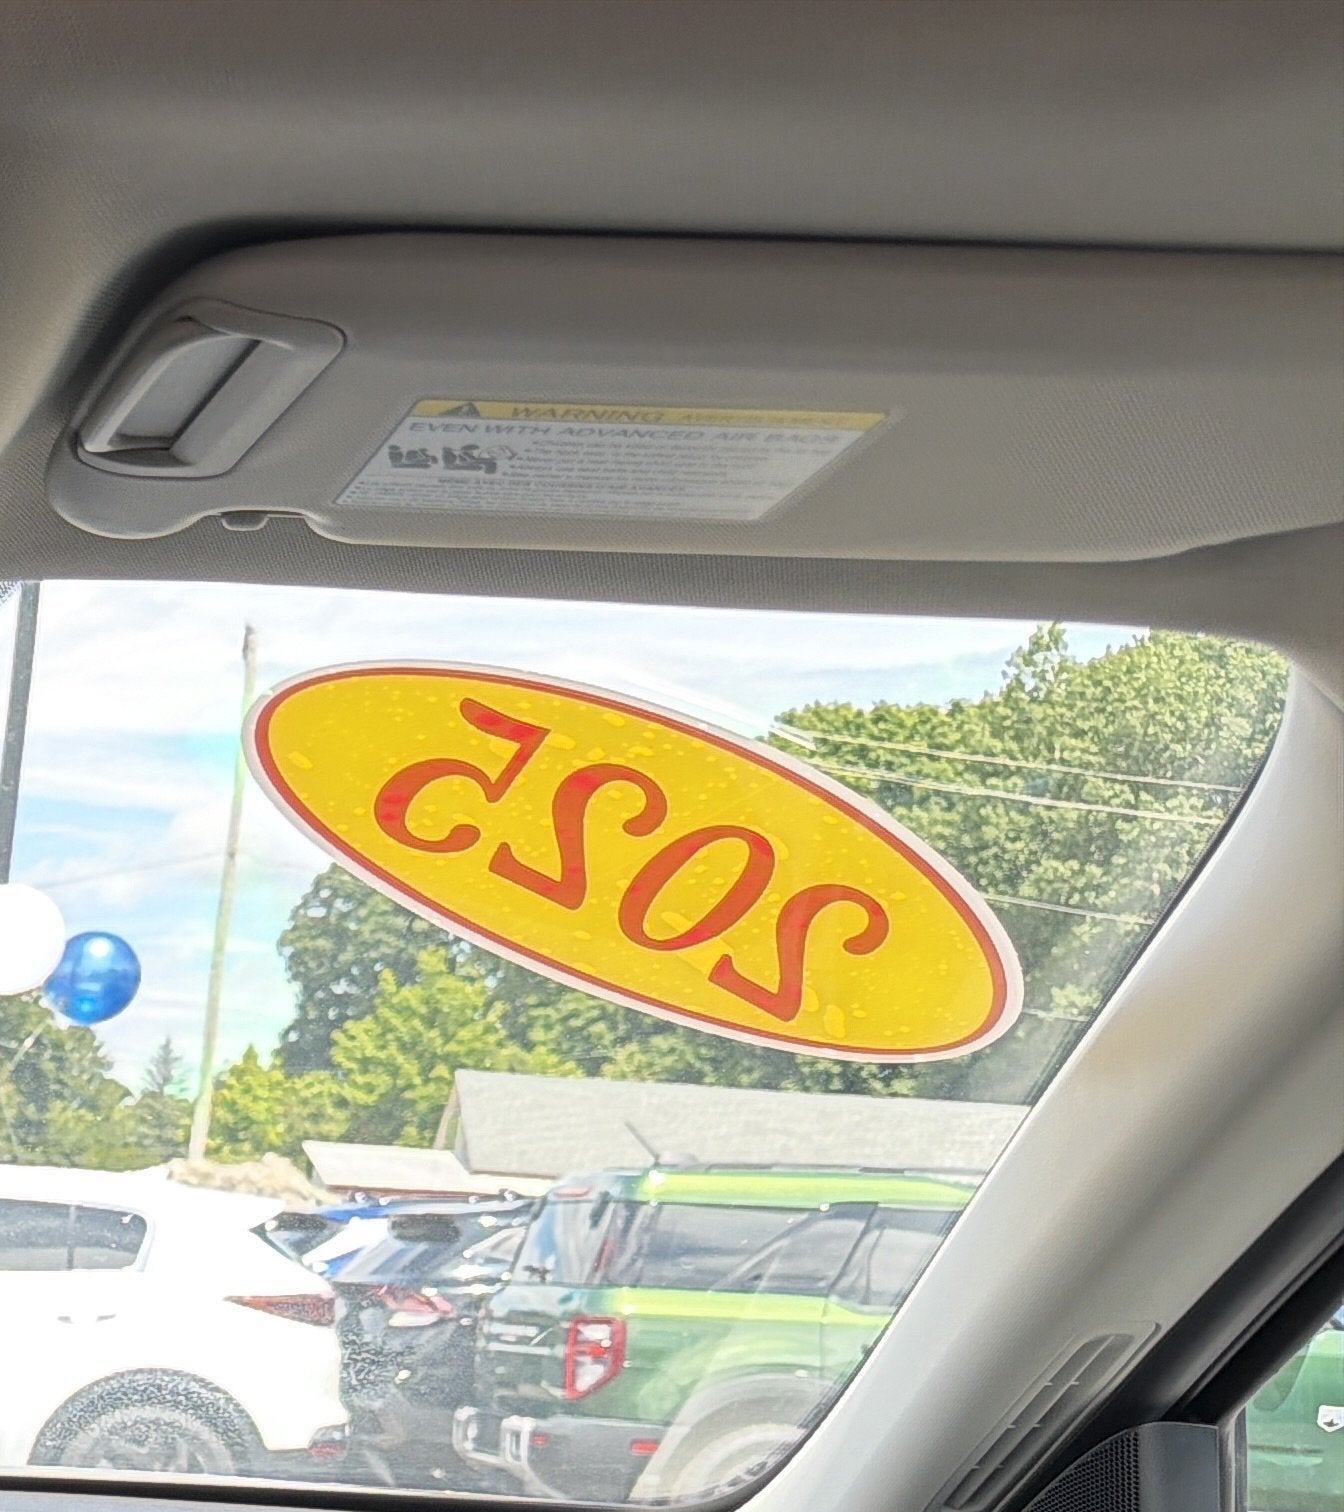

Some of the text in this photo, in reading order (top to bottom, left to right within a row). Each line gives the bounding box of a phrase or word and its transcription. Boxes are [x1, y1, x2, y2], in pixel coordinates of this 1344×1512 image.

[512, 404, 665, 424] WARNING
[409, 421, 479, 434] EVEN
[484, 423, 552, 436] WITH
[562, 425, 706, 441] ADVANCED
